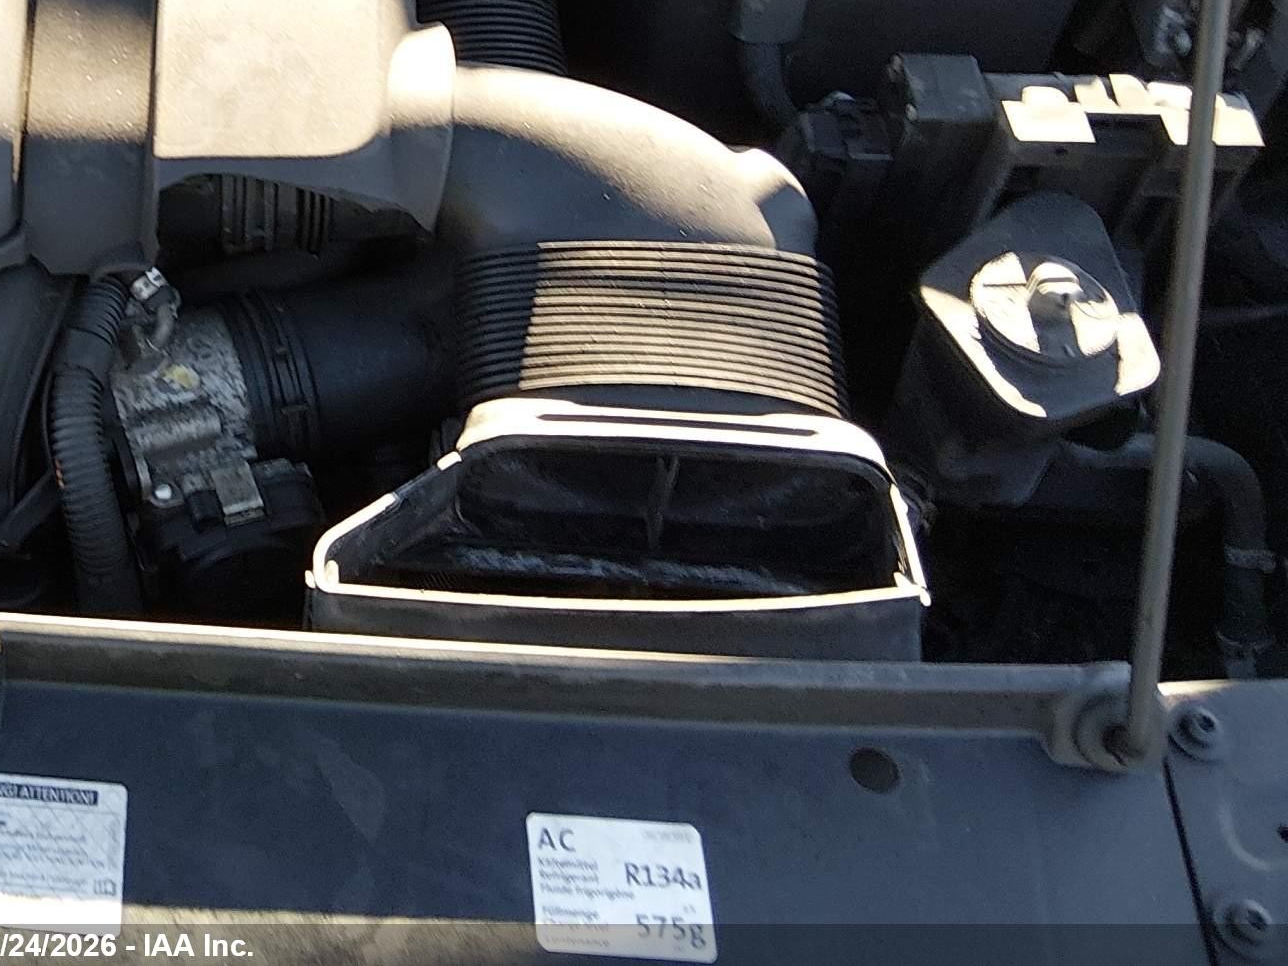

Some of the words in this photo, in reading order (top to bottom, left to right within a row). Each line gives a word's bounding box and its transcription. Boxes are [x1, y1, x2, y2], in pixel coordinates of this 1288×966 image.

[537, 827, 576, 852] AC
[623, 861, 703, 891] R134a
[634, 913, 707, 950] 575g
